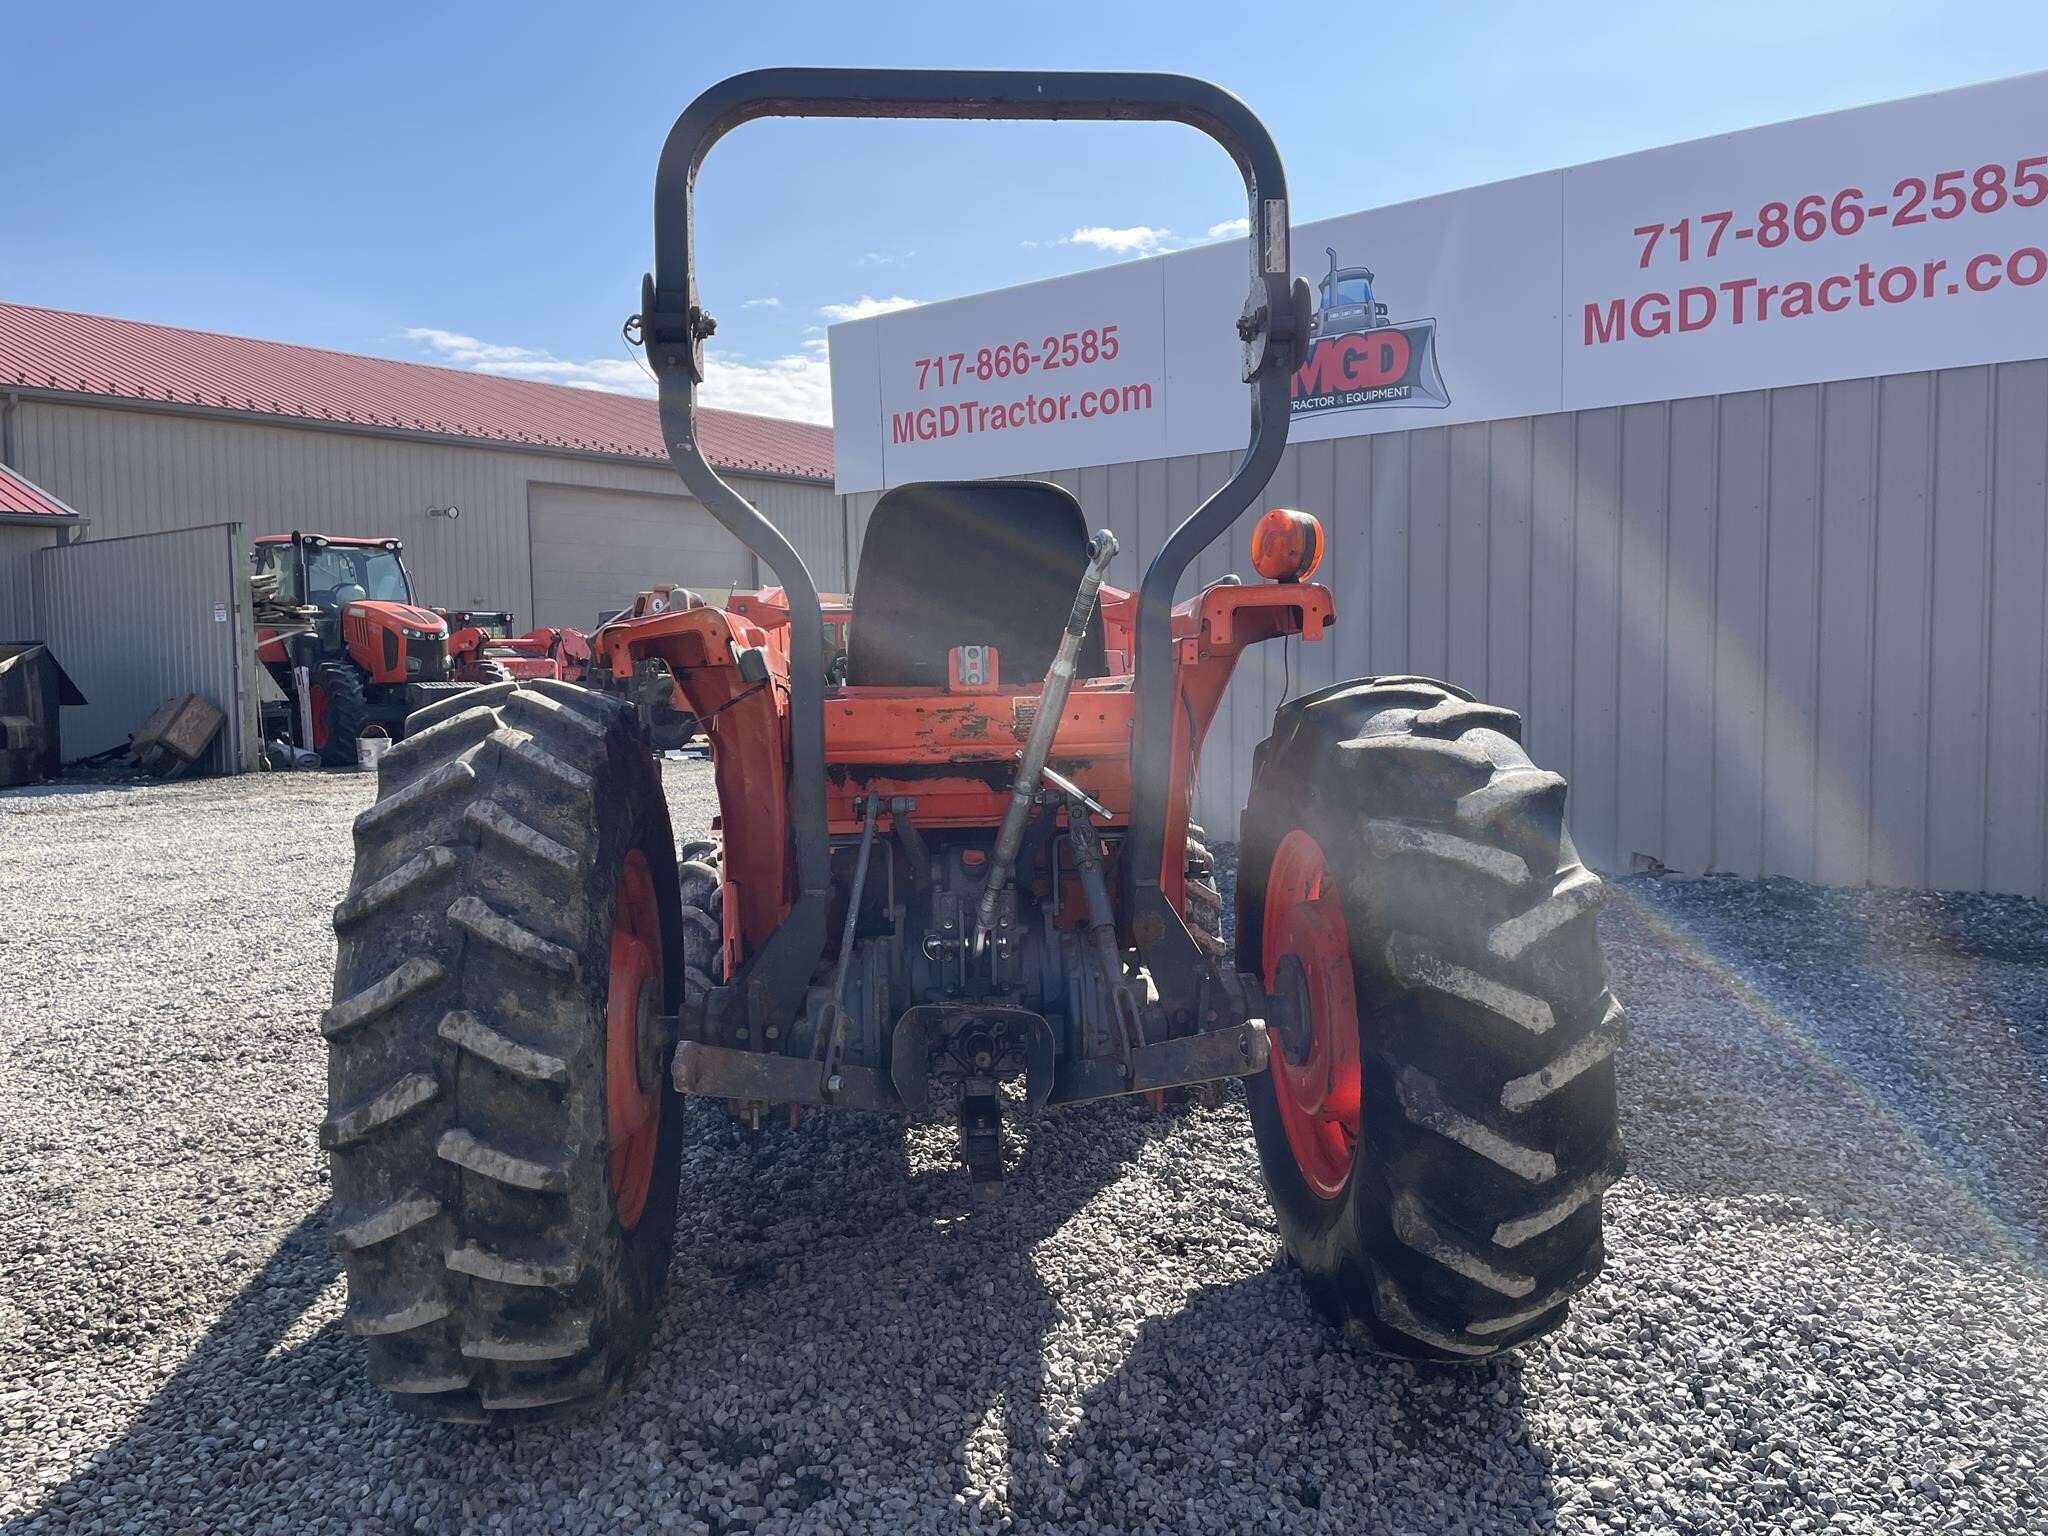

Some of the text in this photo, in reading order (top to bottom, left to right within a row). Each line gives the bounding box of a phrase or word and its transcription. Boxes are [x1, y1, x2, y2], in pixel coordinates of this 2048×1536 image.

[1634, 156, 2048, 269] 717-866-2585
[915, 325, 1119, 390] 717-866-2585
[1290, 331, 1410, 398] MGD
[892, 382, 1152, 444] MGDTractor.com
[1290, 396, 1335, 411] RACTOR
[1346, 385, 1409, 404] EQUIPMENT
